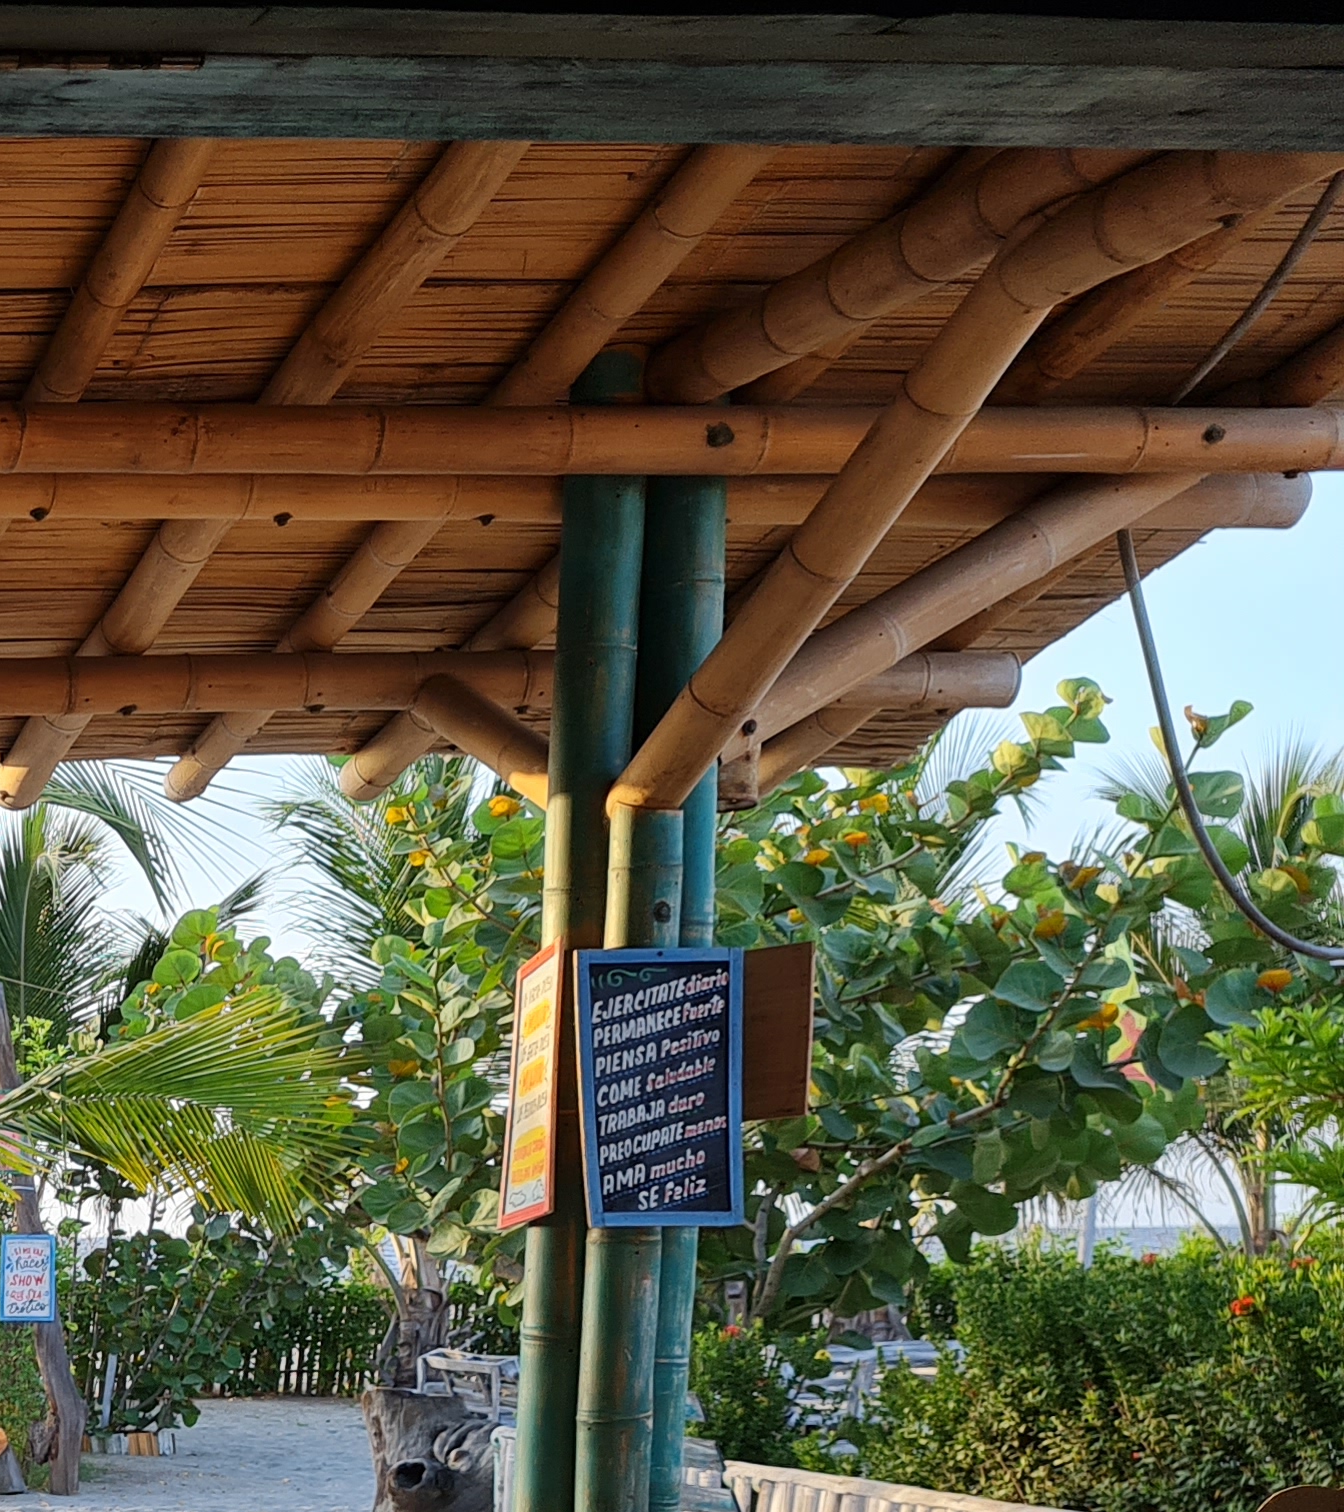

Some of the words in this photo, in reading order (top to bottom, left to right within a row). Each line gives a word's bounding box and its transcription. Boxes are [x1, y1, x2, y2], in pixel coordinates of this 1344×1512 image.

[592, 977, 686, 1024] EJERCITATE
[685, 968, 729, 995] diario
[593, 1005, 682, 1048] PERMANECE
[595, 1040, 657, 1078] PIENSA
[597, 1075, 642, 1107] COME
[598, 1098, 665, 1137] TRABAJA
[668, 1091, 705, 1114] duro
[599, 1121, 685, 1167] PREOCUPATE
[684, 1115, 727, 1138] menos
[603, 1163, 646, 1196] AMA
[650, 1148, 706, 1180] mucho
[638, 1185, 659, 1211] SE
[10, 1273, 45, 1286] SHOW
